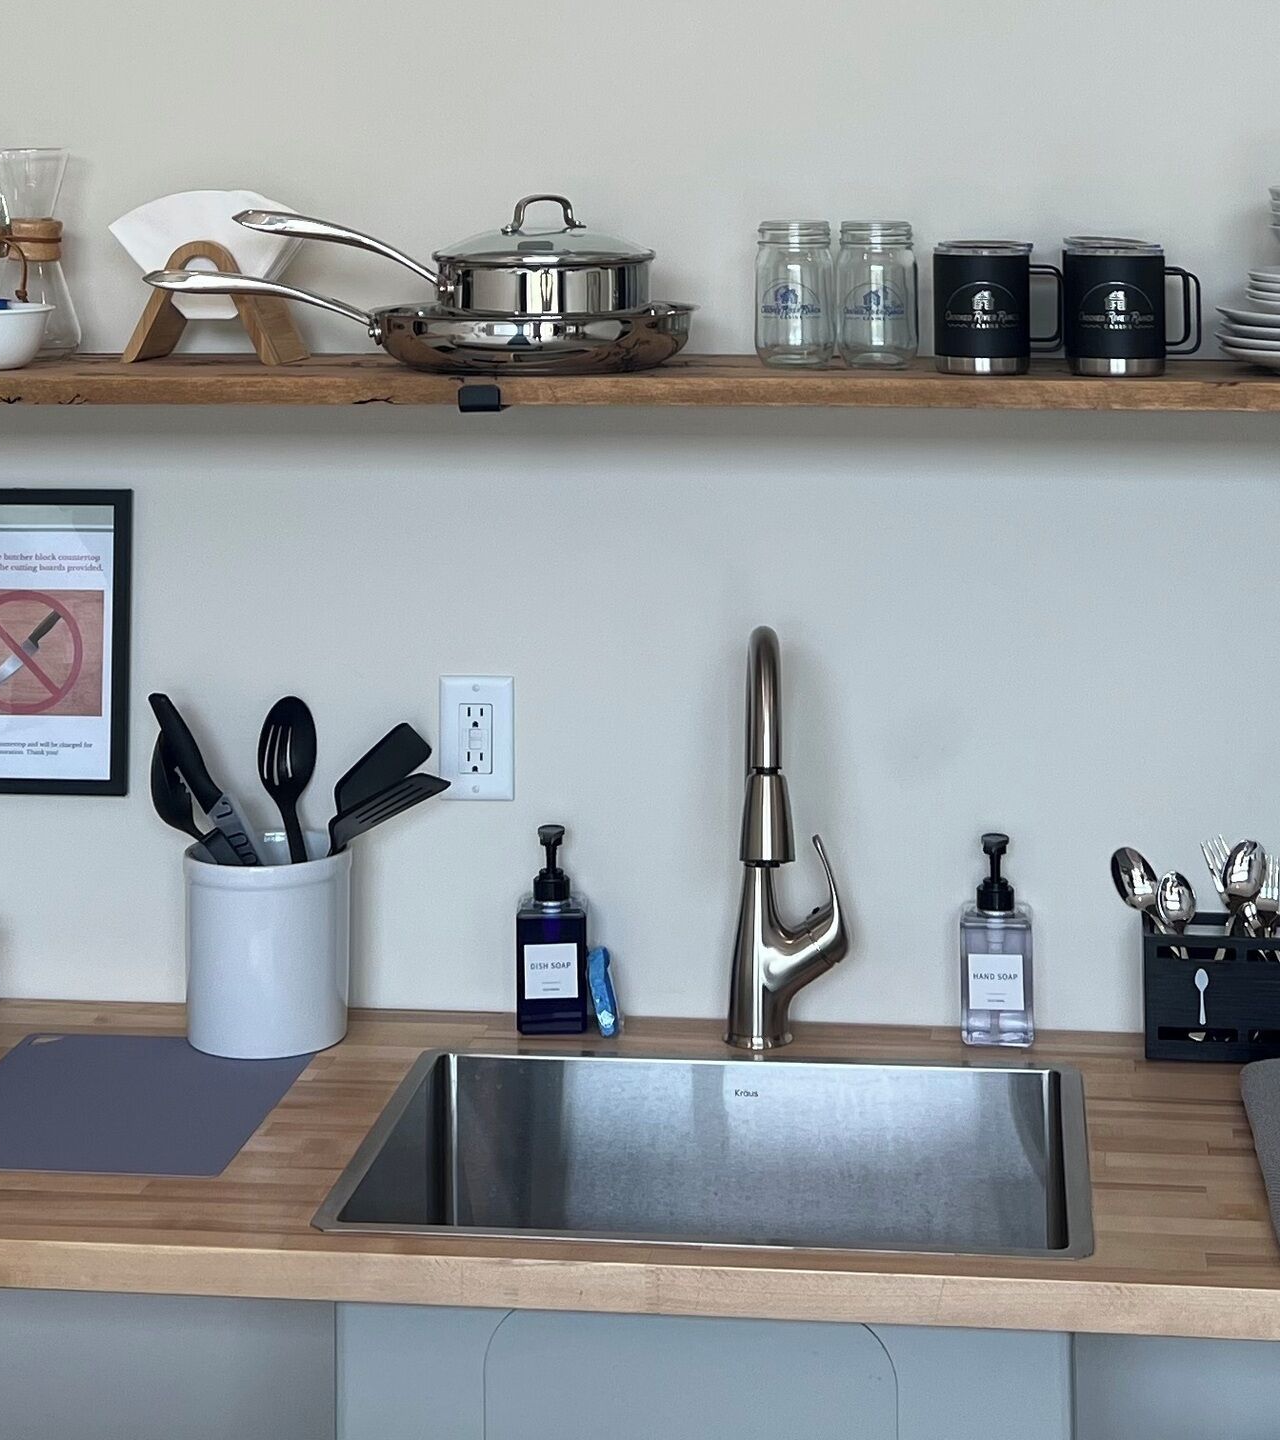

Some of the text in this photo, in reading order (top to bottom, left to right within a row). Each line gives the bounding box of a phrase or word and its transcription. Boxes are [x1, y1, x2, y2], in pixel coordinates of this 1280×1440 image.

[3, 552, 33, 561] butcher
[34, 552, 57, 561] block
[57, 554, 101, 562] countertop
[10, 564, 38, 573] cutting
[39, 563, 66, 571] boards
[67, 563, 104, 573] provided.
[530, 961, 572, 970] DISH SOAP
[972, 973, 1018, 981] HAND SOAP
[734, 1089, 759, 1098] Kraus
